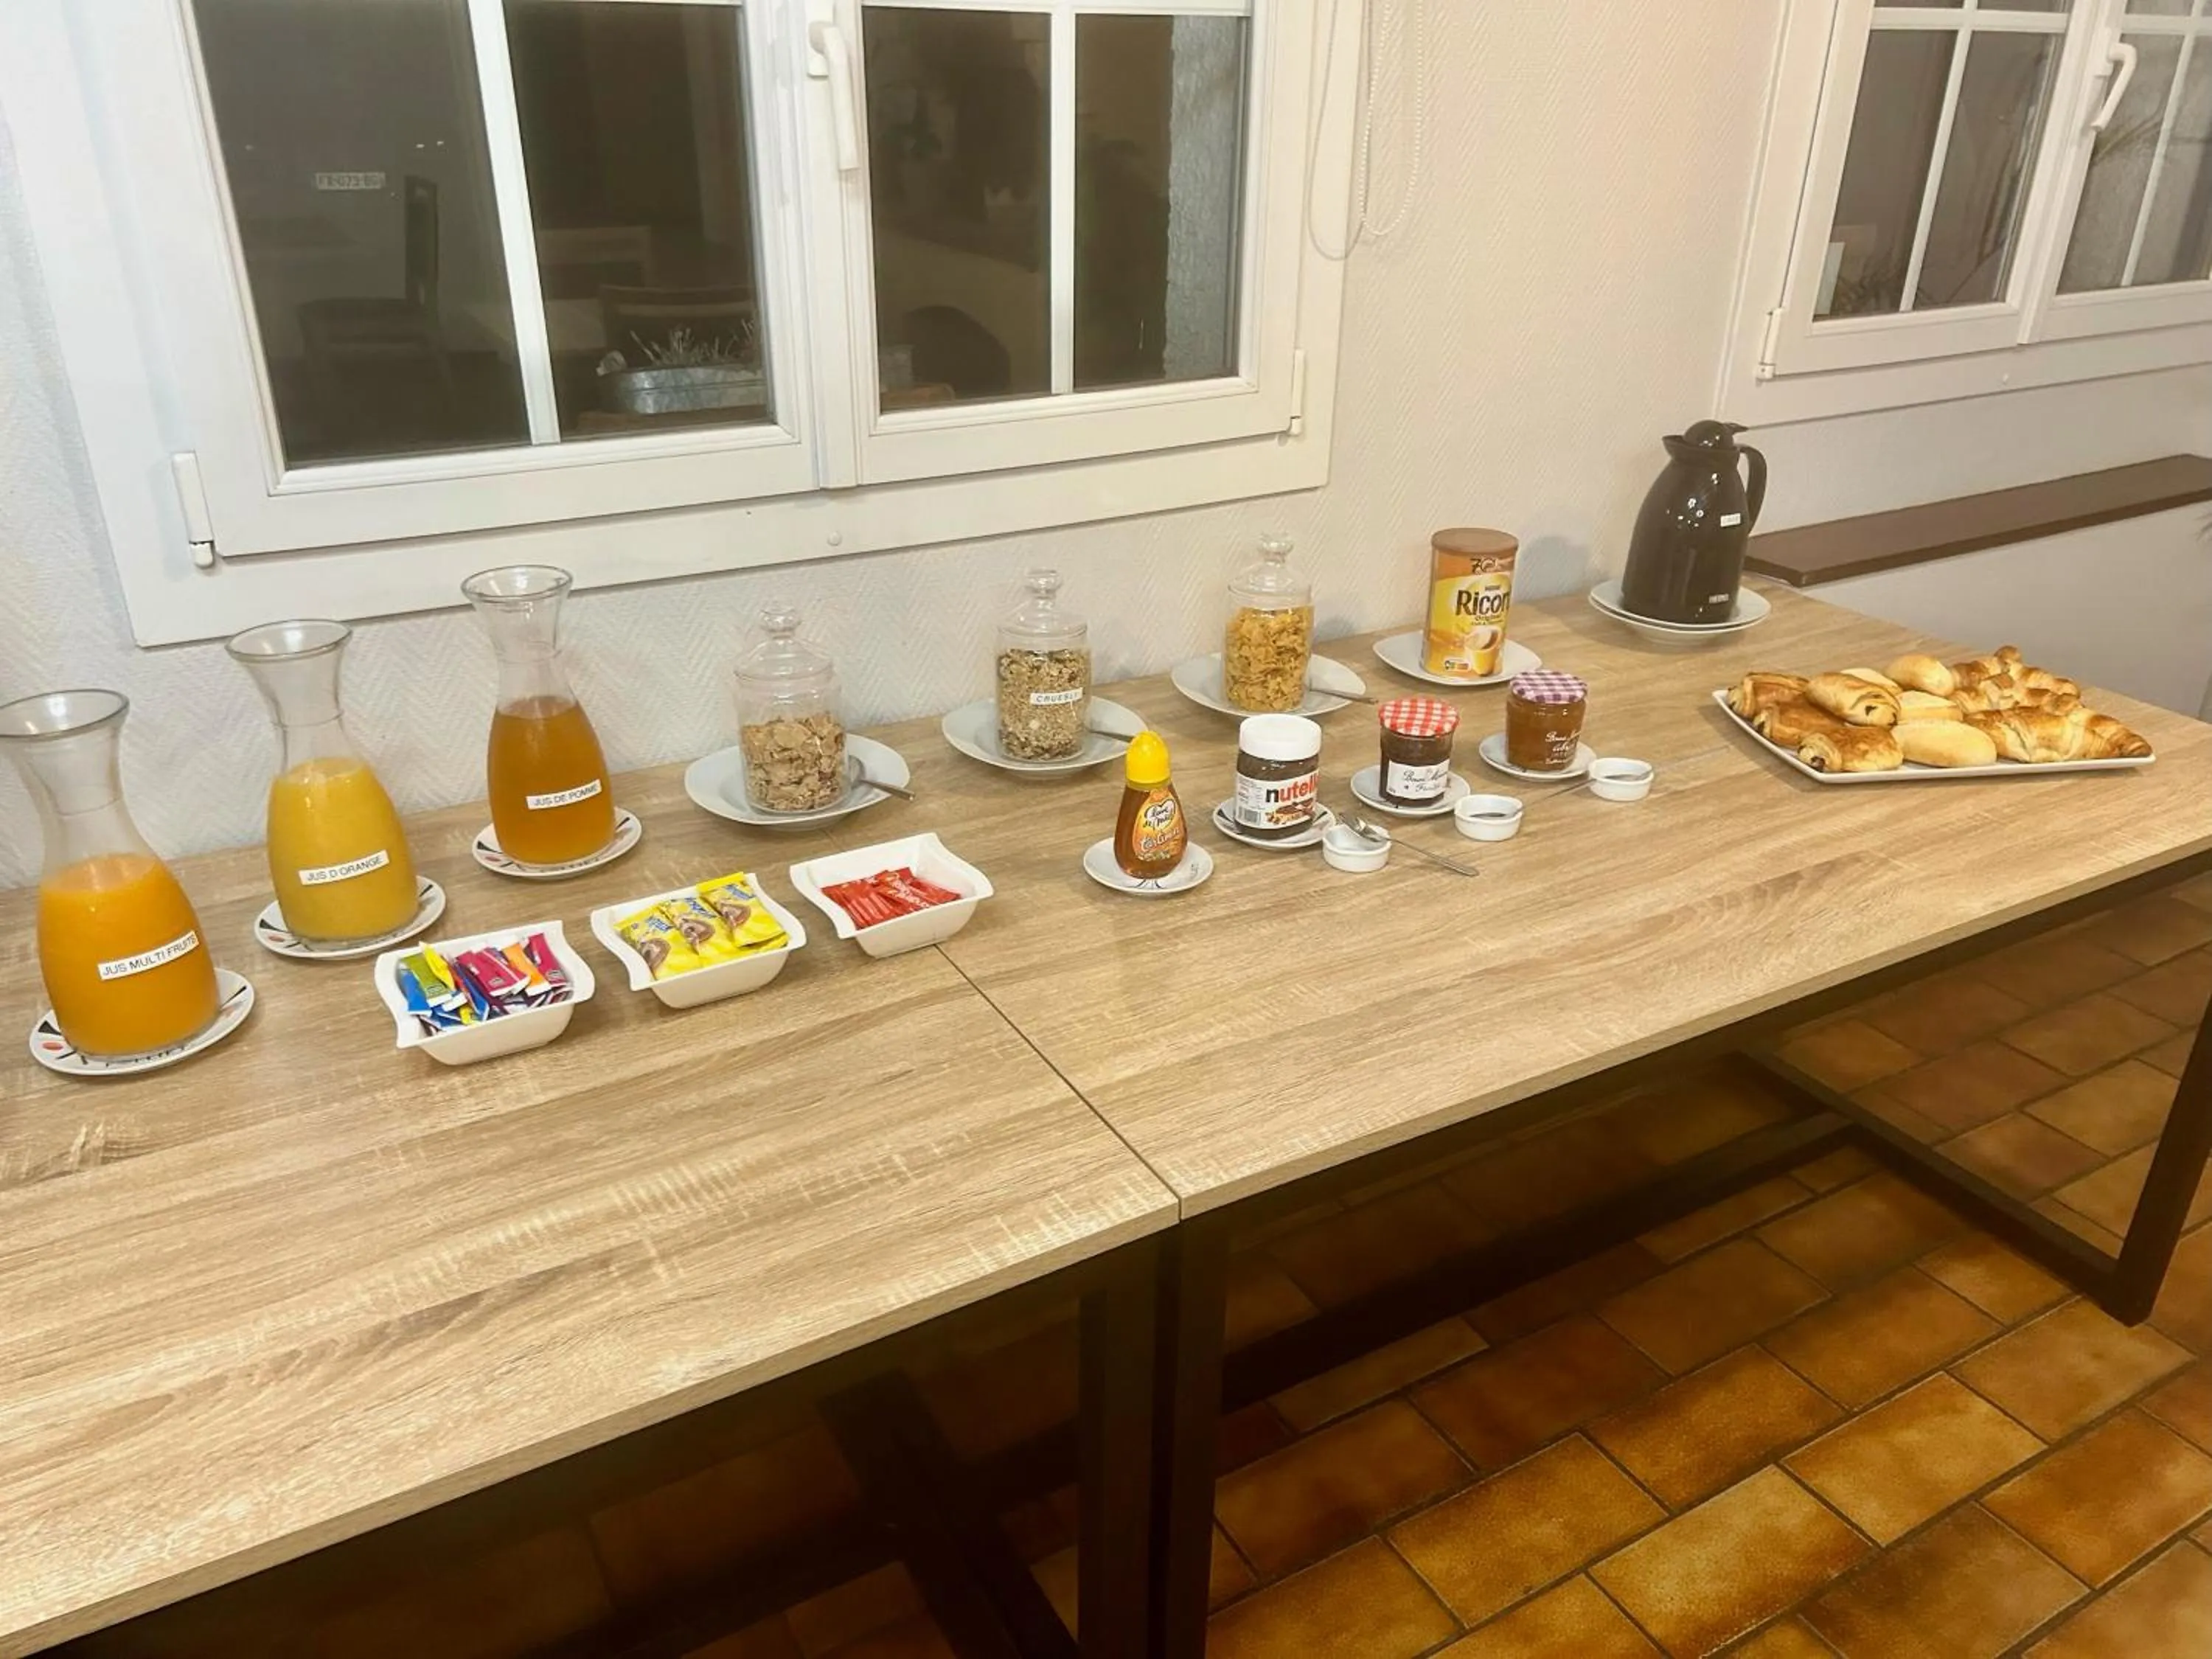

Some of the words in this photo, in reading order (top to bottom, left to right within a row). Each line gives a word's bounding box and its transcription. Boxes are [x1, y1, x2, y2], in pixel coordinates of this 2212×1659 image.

[1455, 589, 1511, 616] Ricor
[535, 797, 552, 807] JUS
[554, 795, 567, 803] DE
[568, 784, 597, 799] POMME
[1265, 773, 1320, 803] nutell
[307, 871, 327, 881] JUS
[102, 963, 128, 975] JUS
[128, 950, 166, 970] MULTI
[167, 934, 197, 956] FRUITS
